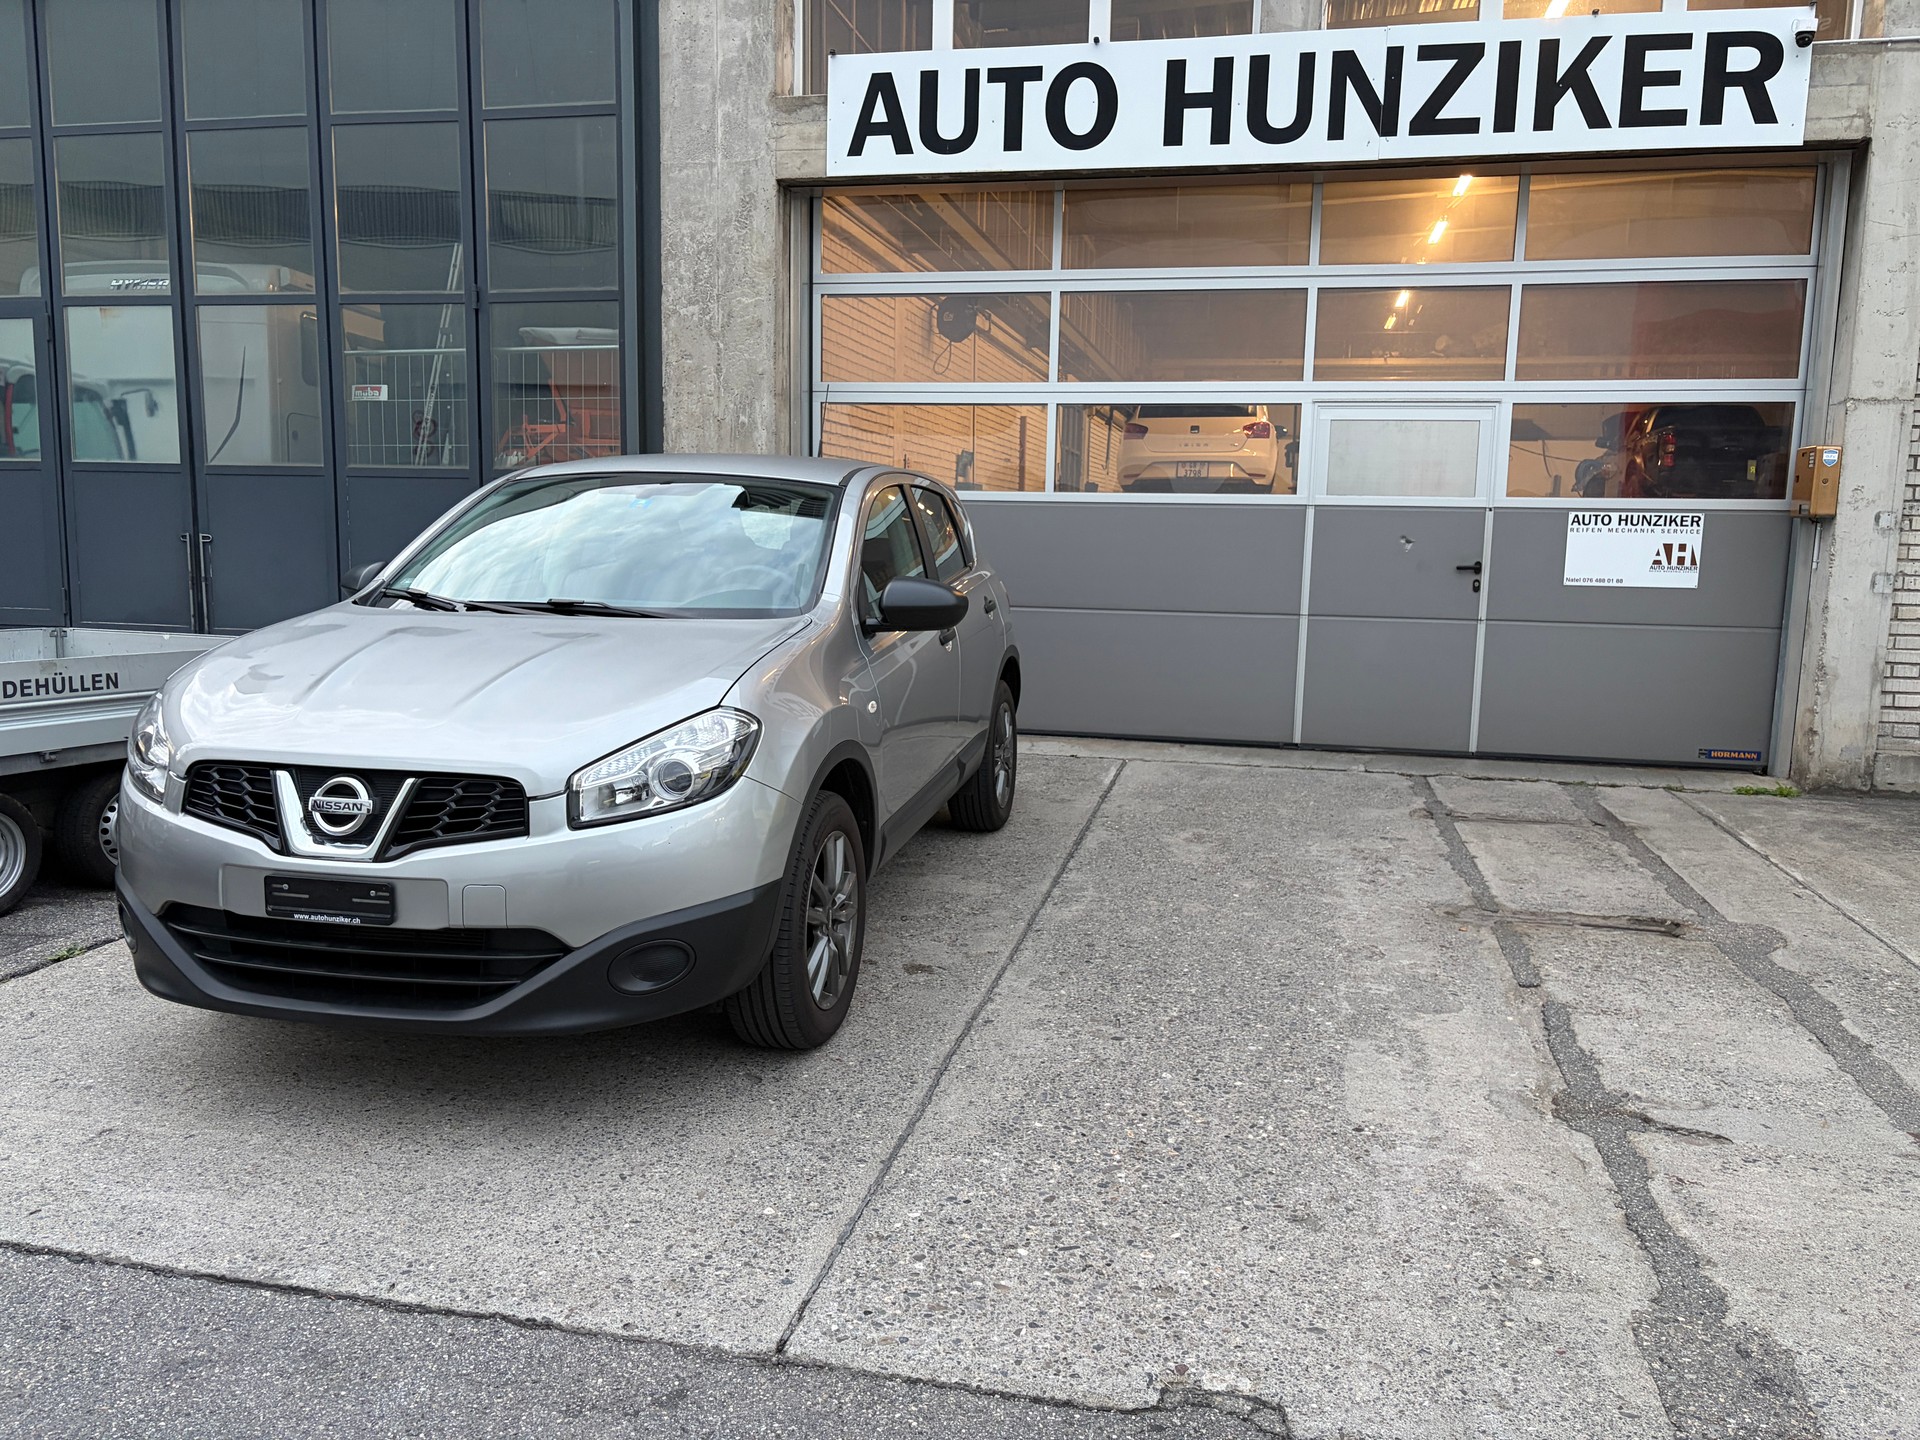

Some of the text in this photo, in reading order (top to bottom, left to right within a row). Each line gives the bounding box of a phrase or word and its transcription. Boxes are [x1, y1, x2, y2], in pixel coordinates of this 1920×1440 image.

[847, 31, 1785, 157] AUTO HUNZIKER
[110, 279, 169, 290] HYMER
[1571, 514, 1701, 527] AUTO HUNZIKER
[2, 672, 119, 699] DEHÜLLEN
[313, 800, 363, 811] NISSAN
[293, 913, 361, 924] www.autohunziker.ch
